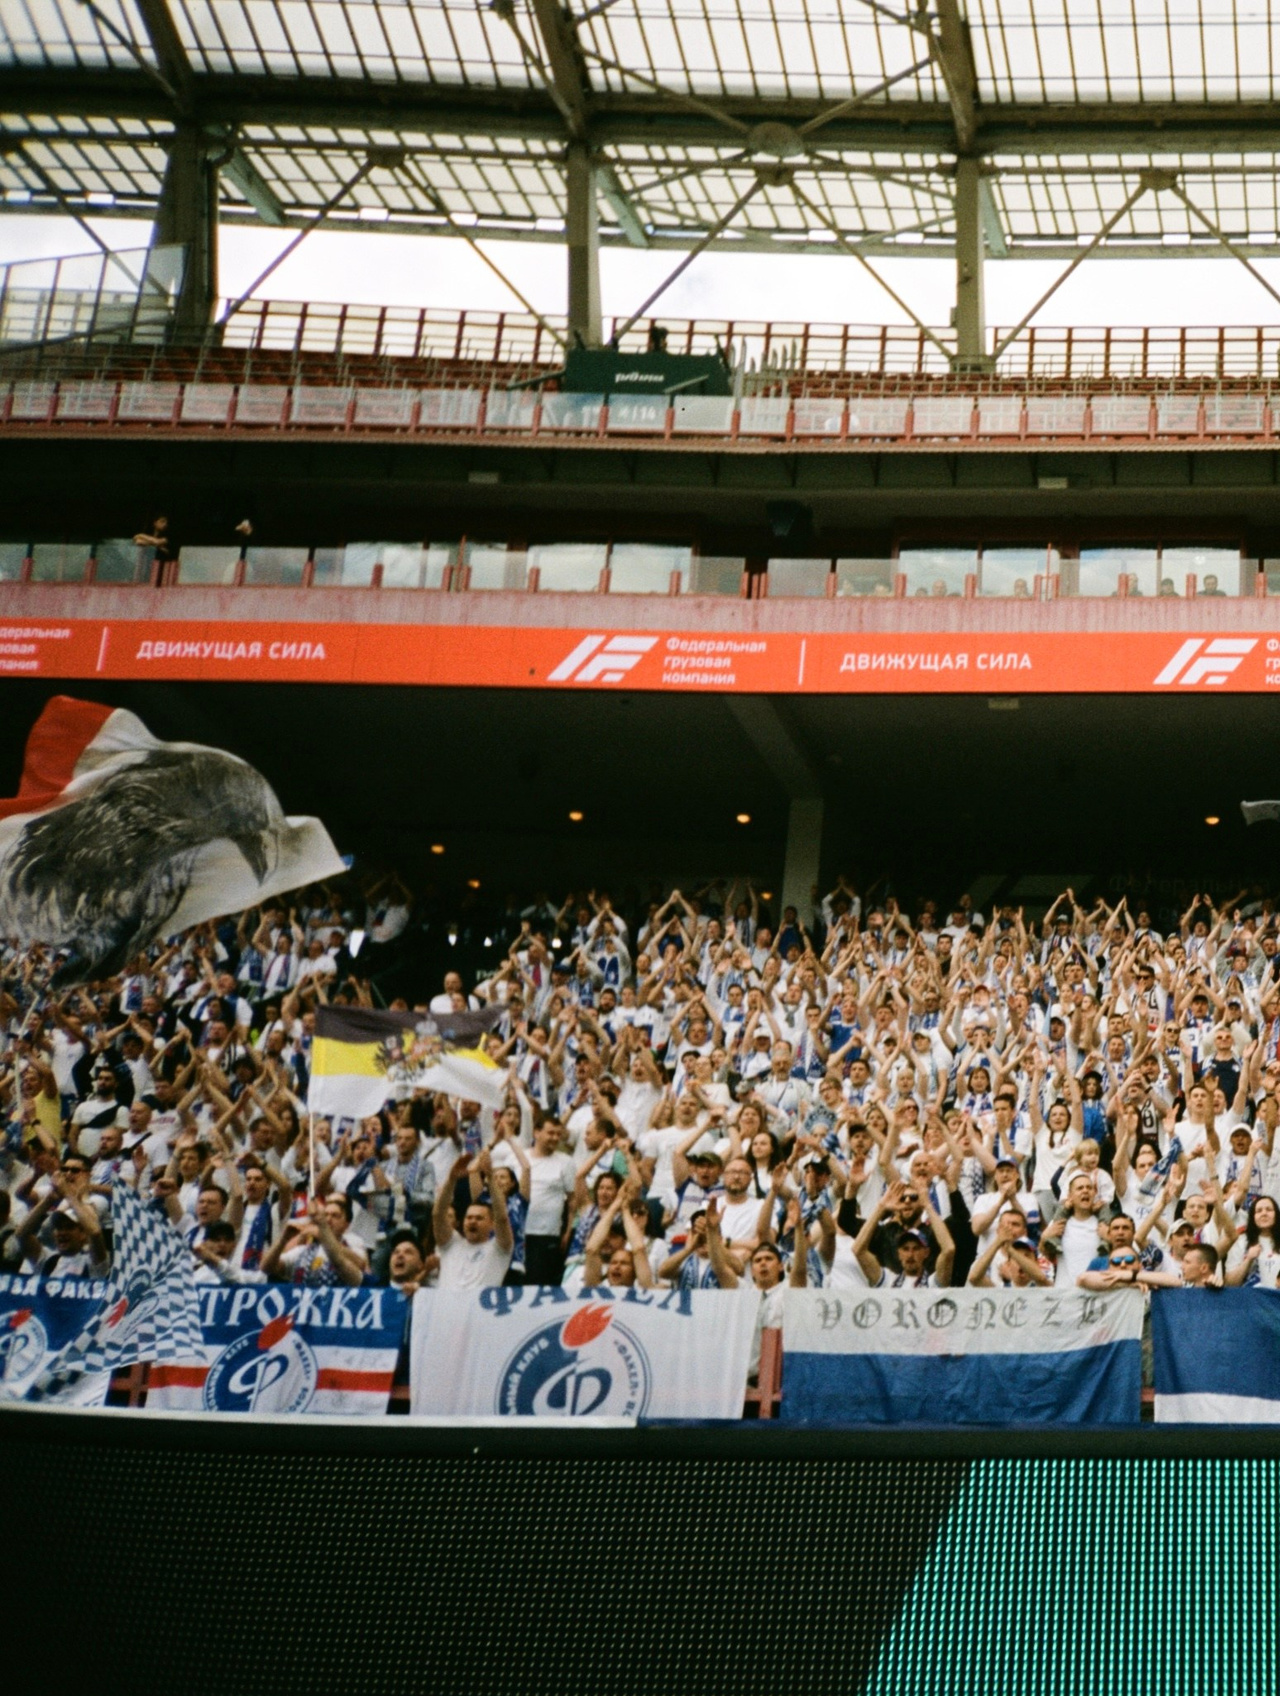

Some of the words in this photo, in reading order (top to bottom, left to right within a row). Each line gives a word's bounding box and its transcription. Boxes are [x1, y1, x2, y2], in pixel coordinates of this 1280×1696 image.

[136, 640, 263, 661] ДВИЖУЩАЯ
[268, 641, 327, 660] СИЛА
[666, 636, 767, 654] Федеральная
[663, 655, 732, 670] грузовая
[839, 652, 969, 673] ДВИЖУЩАЯ
[976, 652, 1033, 671] СИЛА
[662, 672, 736, 685] компания
